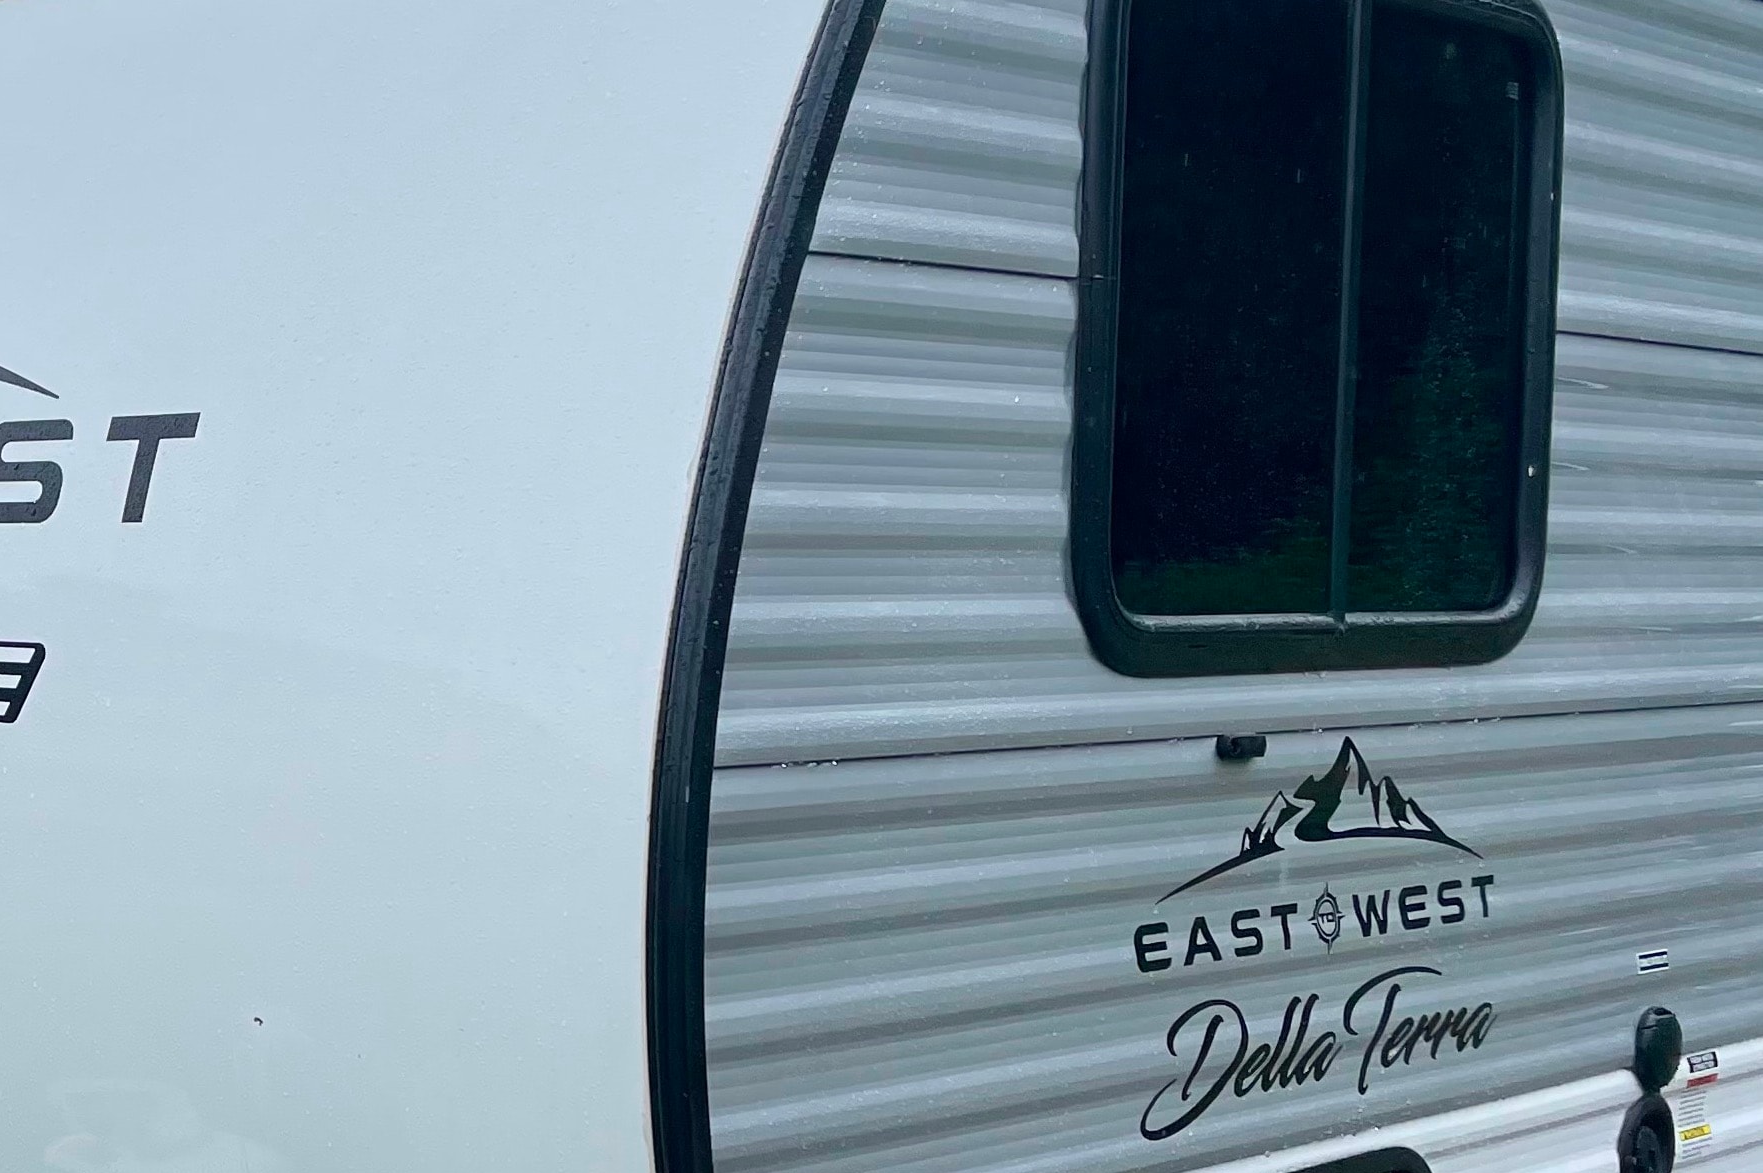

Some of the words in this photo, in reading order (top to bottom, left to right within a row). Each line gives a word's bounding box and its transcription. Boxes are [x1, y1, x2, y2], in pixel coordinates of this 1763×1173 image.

[1133, 902, 1298, 974] EAST
[1351, 874, 1495, 938] WEST
[1139, 993, 1343, 1141] Della
[1343, 965, 1498, 1096] Terra
